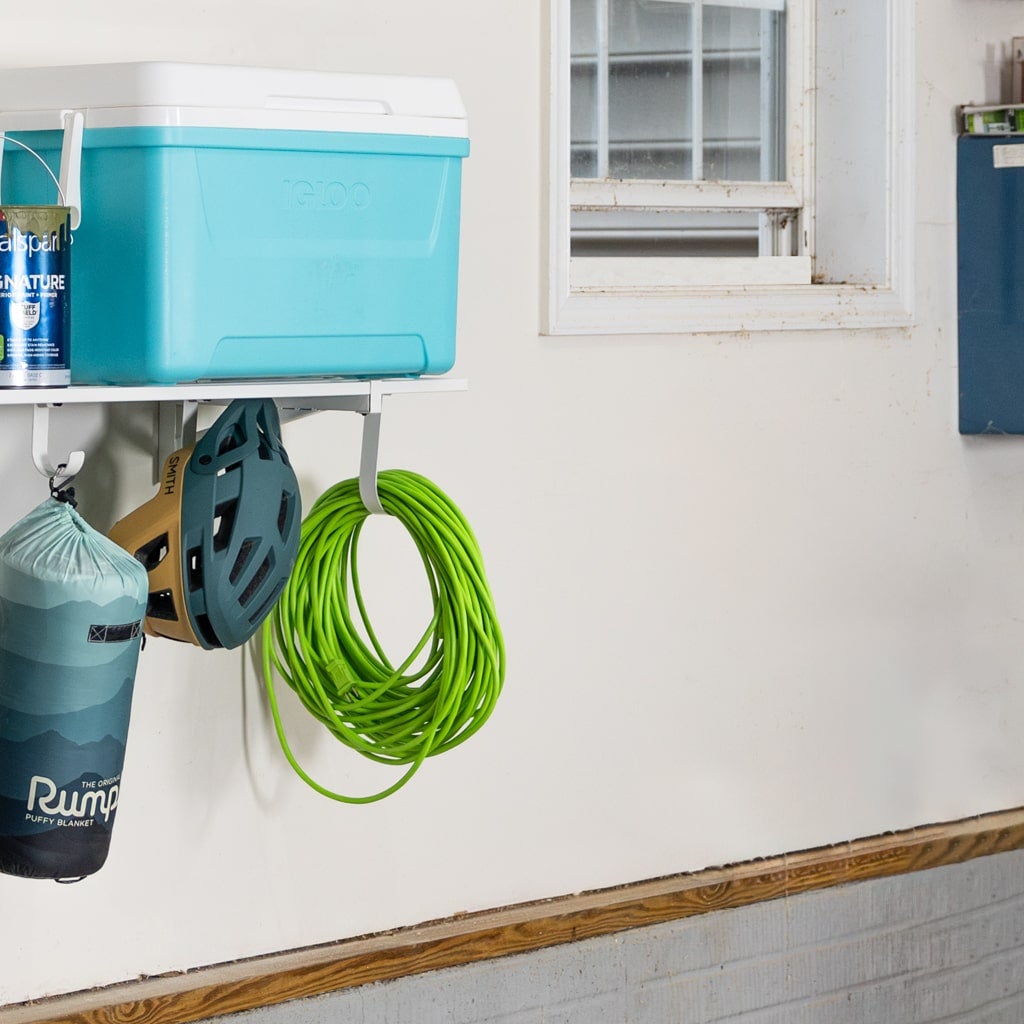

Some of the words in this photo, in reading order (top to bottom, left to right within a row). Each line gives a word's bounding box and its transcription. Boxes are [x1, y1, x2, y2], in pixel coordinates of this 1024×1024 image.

[164, 455, 180, 496] SMITH
[81, 780, 96, 789] THE
[25, 812, 55, 825] PUFFY
[57, 818, 95, 827] BLANKET
